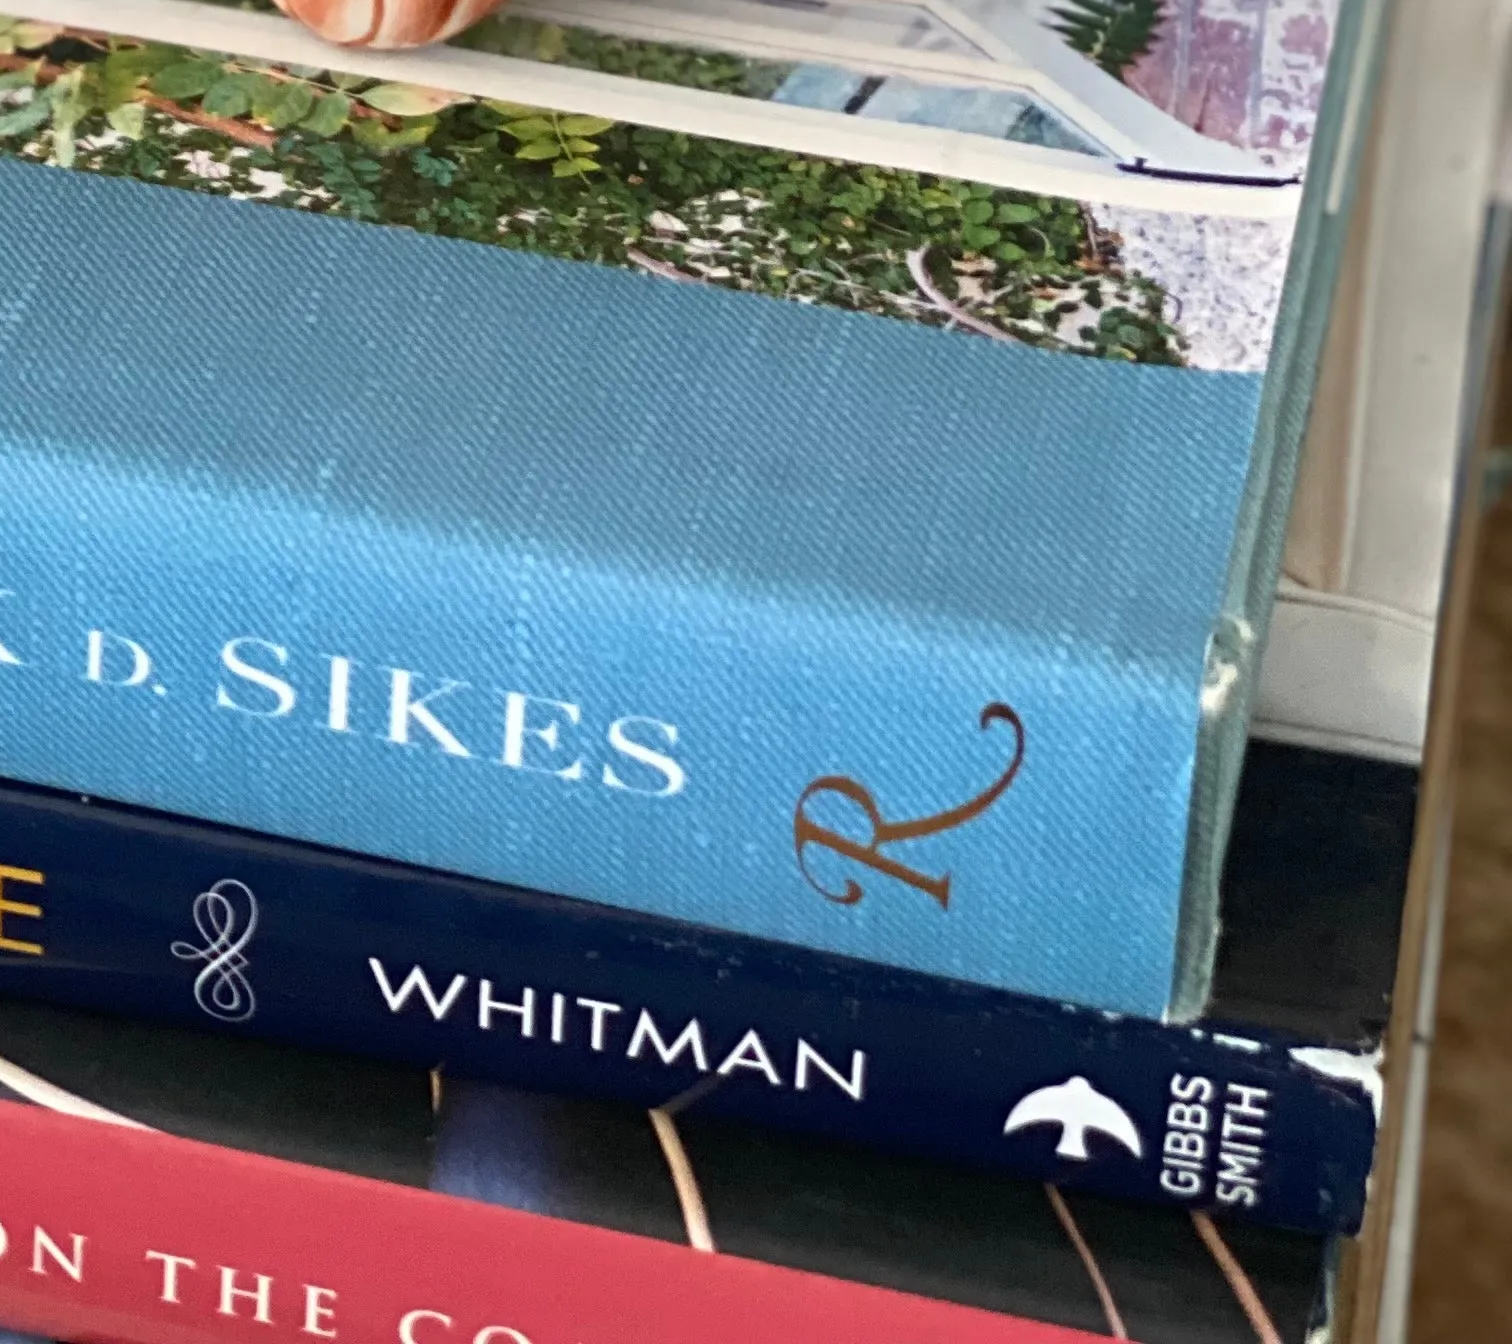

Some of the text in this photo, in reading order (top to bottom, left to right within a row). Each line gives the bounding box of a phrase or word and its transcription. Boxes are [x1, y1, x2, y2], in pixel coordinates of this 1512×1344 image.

[217, 638, 687, 798] SIKES
[367, 957, 866, 1102] WHITMAN
[1159, 1072, 1214, 1197] GIBBS
[1215, 1082, 1271, 1208] SMITH
[144, 1250, 338, 1338] THE
